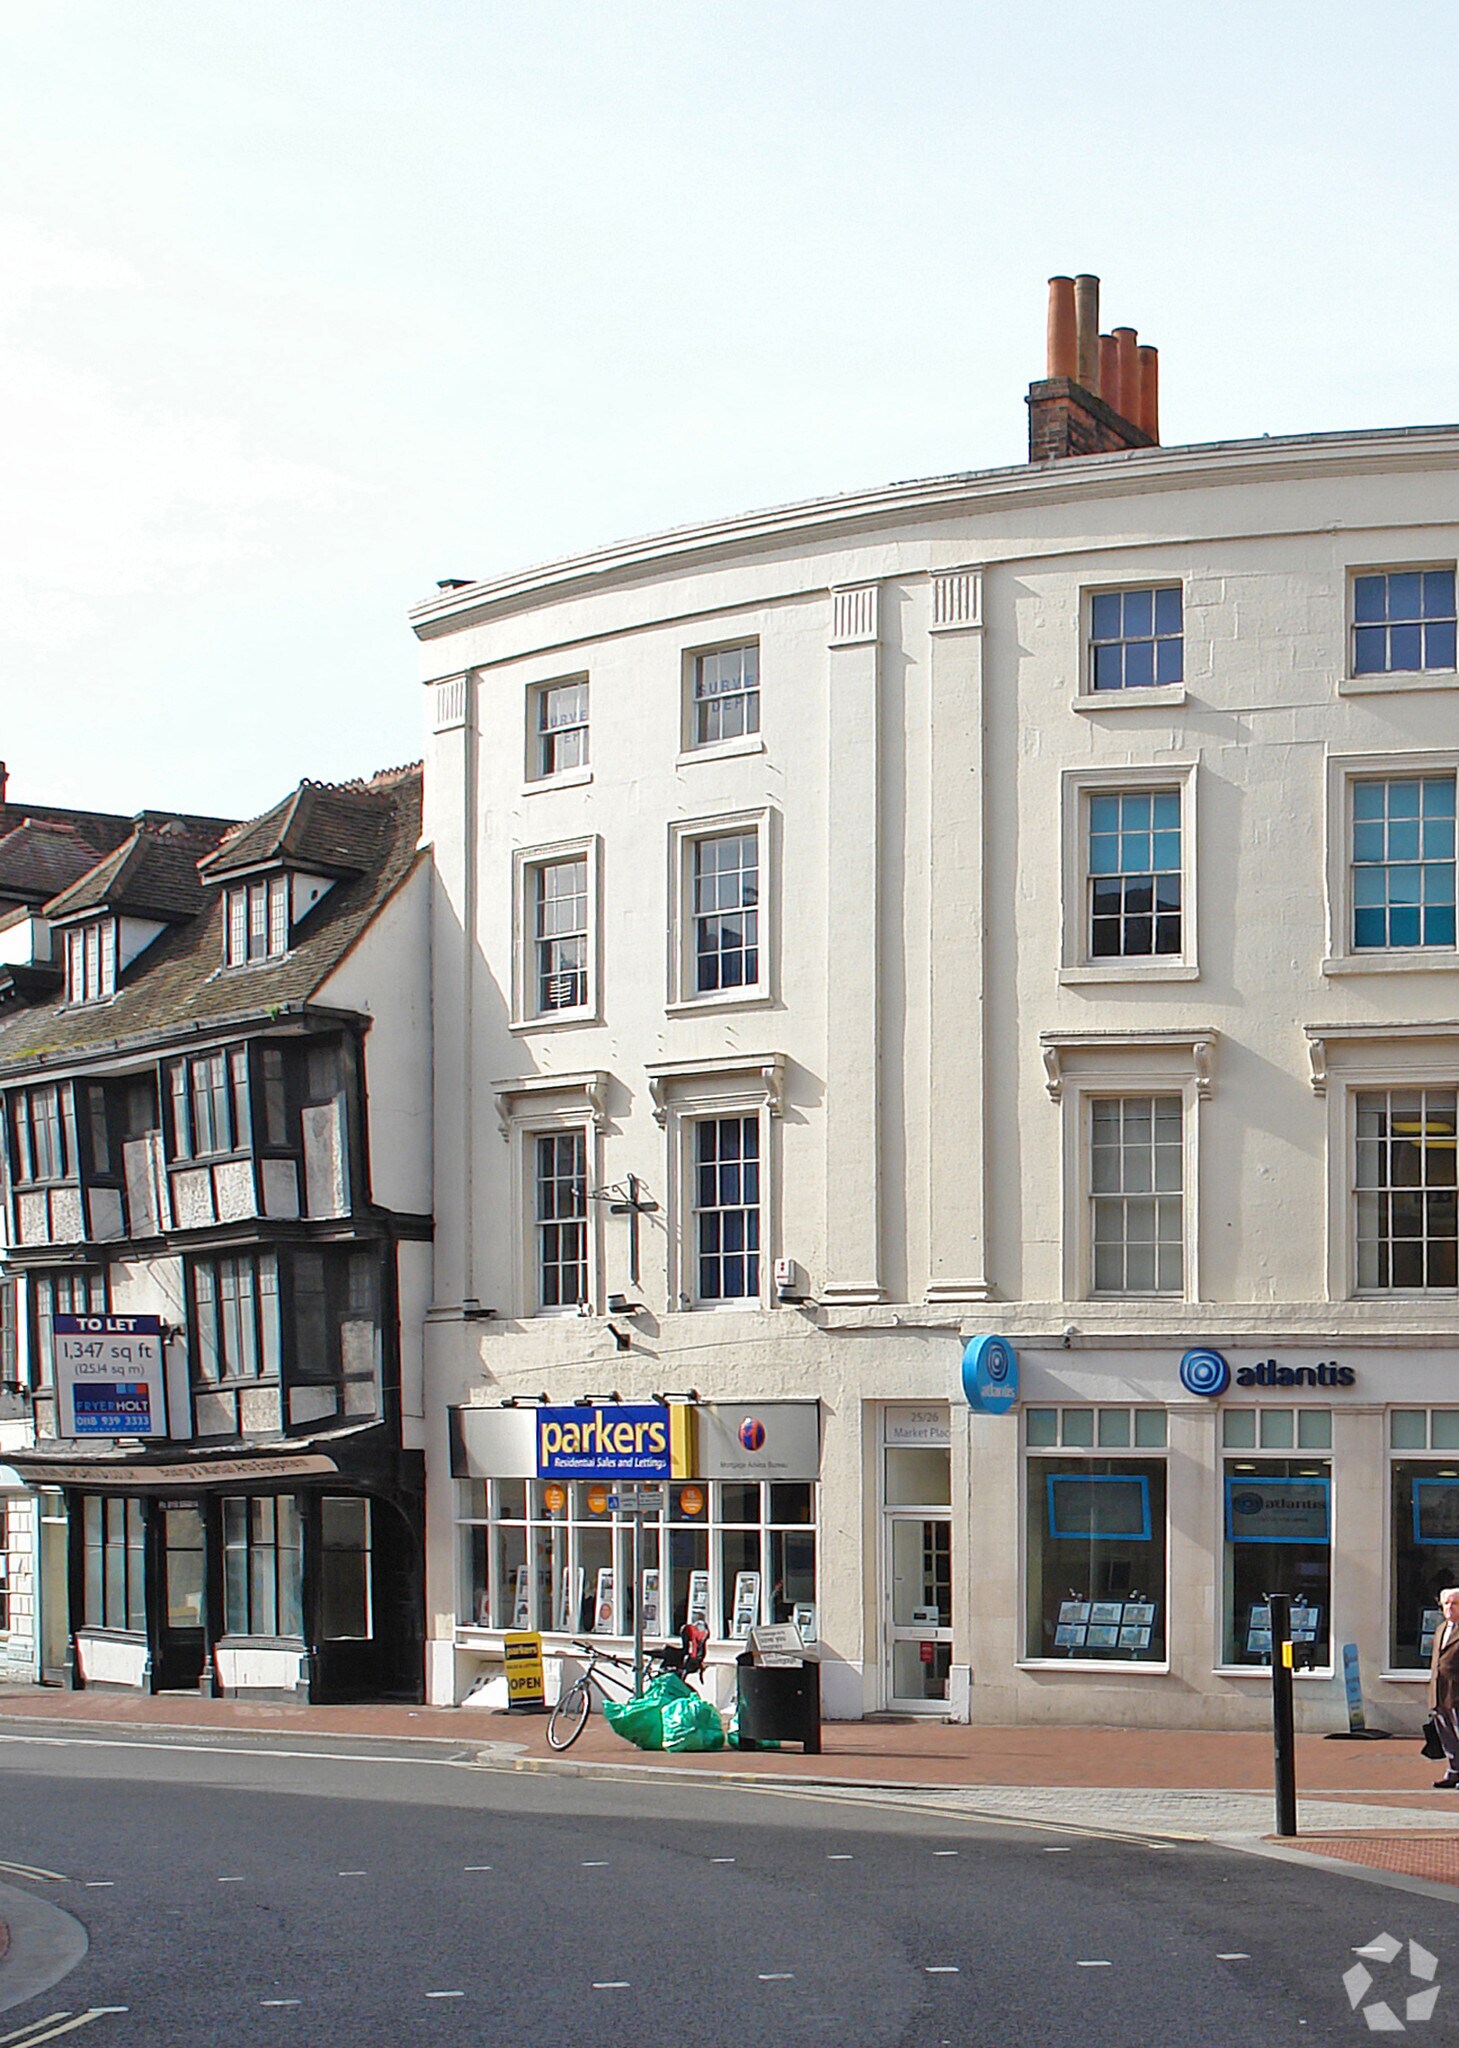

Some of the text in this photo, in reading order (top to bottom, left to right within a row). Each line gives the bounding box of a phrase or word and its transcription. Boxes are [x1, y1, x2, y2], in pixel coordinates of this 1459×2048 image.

[76, 1318, 137, 1331] TO LET
[64, 1342, 152, 1362] 1,347 sq ft
[112, 1366, 125, 1376] sq
[128, 1364, 145, 1376] m)
[1236, 1359, 1356, 1387] atlantis
[981, 1382, 1015, 1398] atlantis
[910, 1412, 939, 1422] 25/26
[541, 1409, 667, 1467] parkers
[893, 1428, 950, 1438] Market Plac
[554, 1457, 667, 1470] Residential Sales and Lettings
[1265, 1499, 1326, 1509] atlantis
[510, 1677, 541, 1690] OPEN
